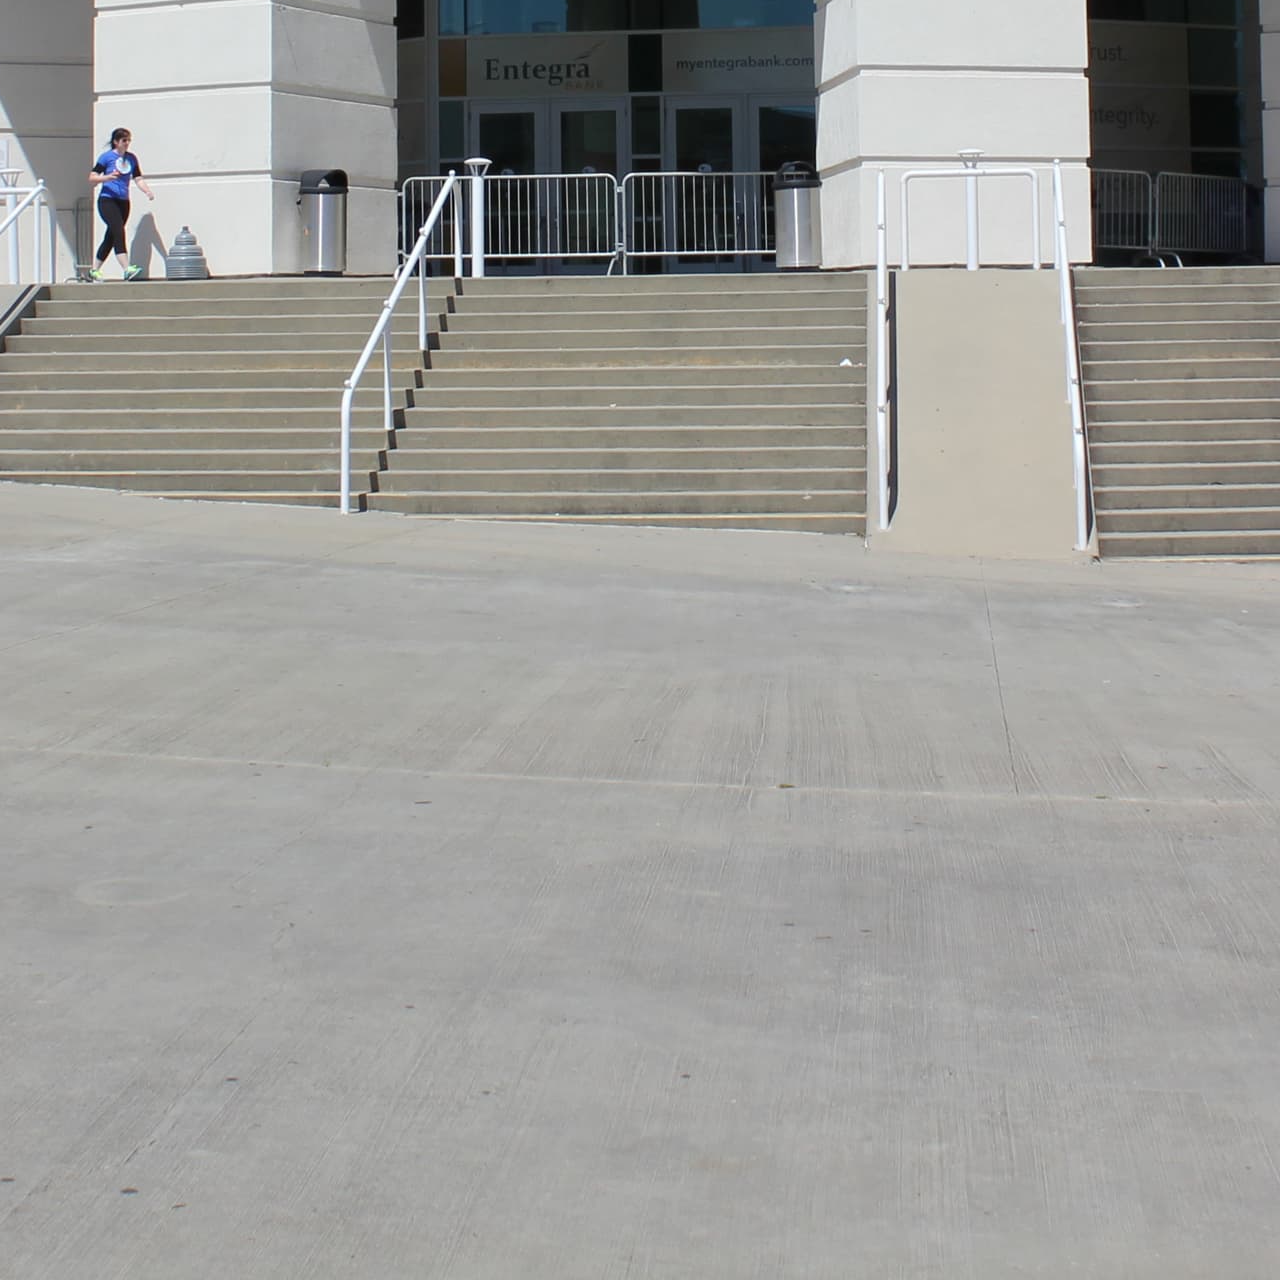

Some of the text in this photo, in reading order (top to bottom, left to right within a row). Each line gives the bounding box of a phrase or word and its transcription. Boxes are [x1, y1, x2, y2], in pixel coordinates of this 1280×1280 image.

[676, 55, 814, 72] myentegrabank.com
[1089, 44, 1128, 62] rust.
[485, 57, 591, 87] Entegra
[1094, 104, 1161, 132] tegrity.
